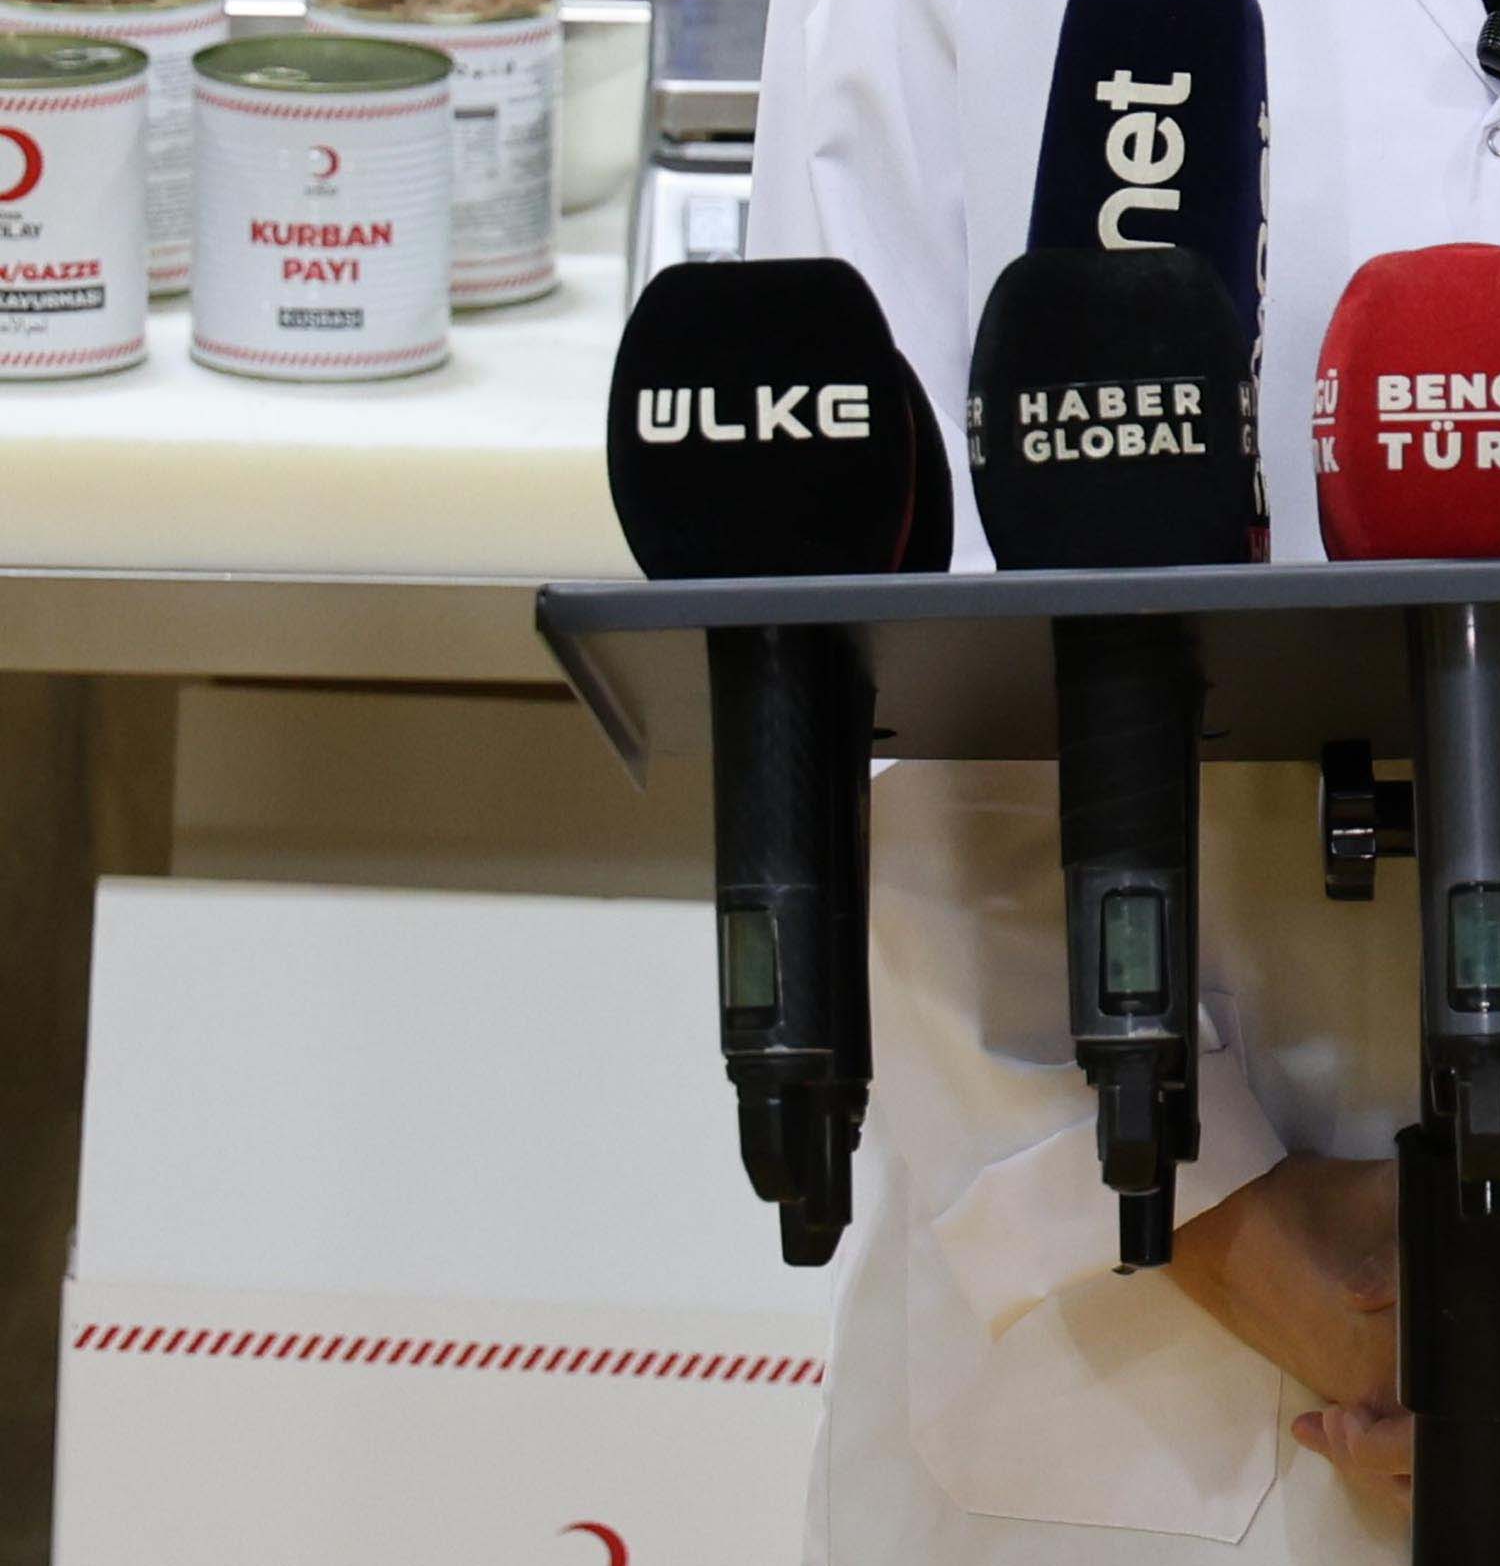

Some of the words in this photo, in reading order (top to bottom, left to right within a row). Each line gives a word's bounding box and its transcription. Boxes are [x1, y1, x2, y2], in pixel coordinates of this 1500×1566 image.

[250, 220, 394, 248] KURBAN
[282, 257, 361, 282] PAYI
[1019, 383, 1202, 424] HABER
[1021, 422, 1206, 463] GLOBAL
